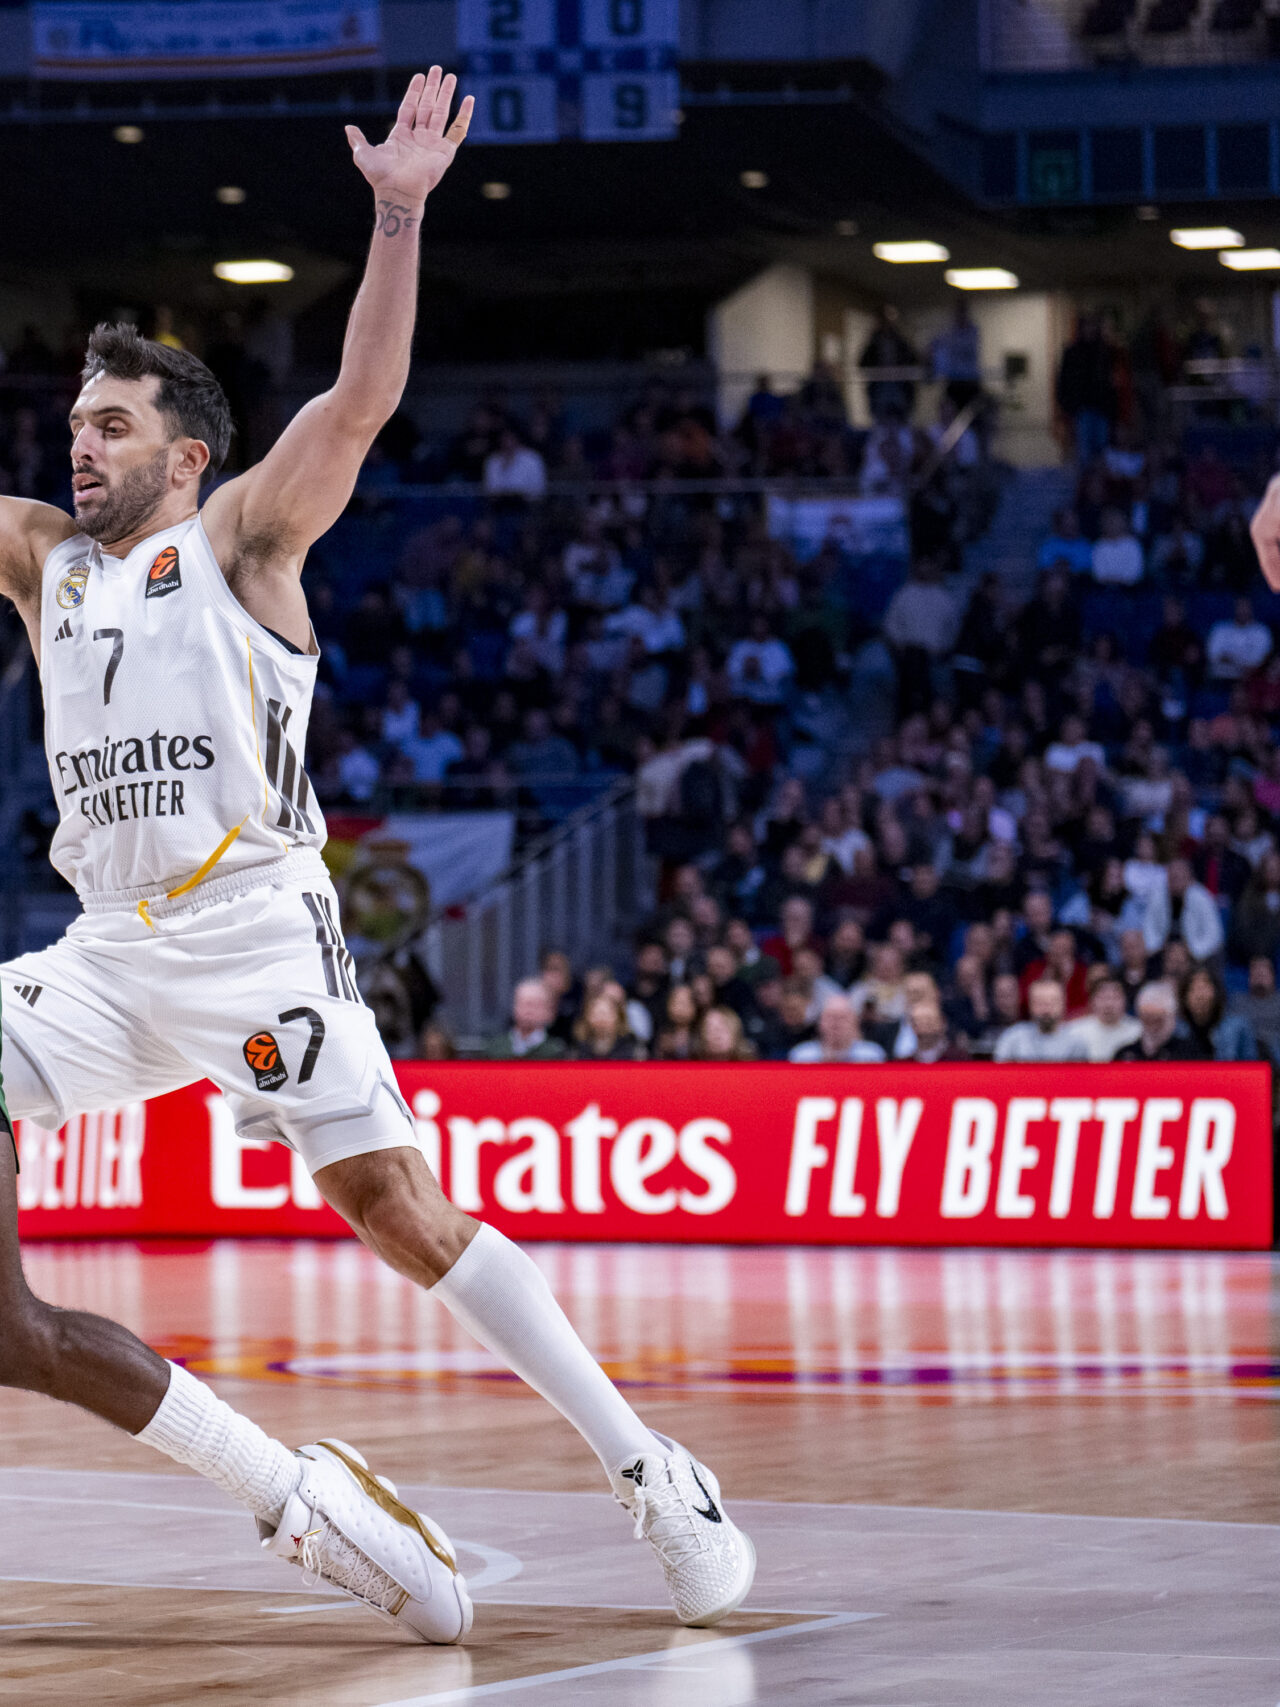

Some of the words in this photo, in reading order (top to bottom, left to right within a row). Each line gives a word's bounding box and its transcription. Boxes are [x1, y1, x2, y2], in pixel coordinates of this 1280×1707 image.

[491, 86, 524, 132] 0
[615, 83, 645, 129] 9
[93, 628, 124, 706] 7
[56, 729, 215, 796] Emirates
[111, 780, 185, 822] ETTER
[278, 1006, 325, 1084] 7
[206, 1089, 737, 1214] Eirates
[785, 1097, 925, 1218] FLY
[940, 1097, 1236, 1220] BETTER
